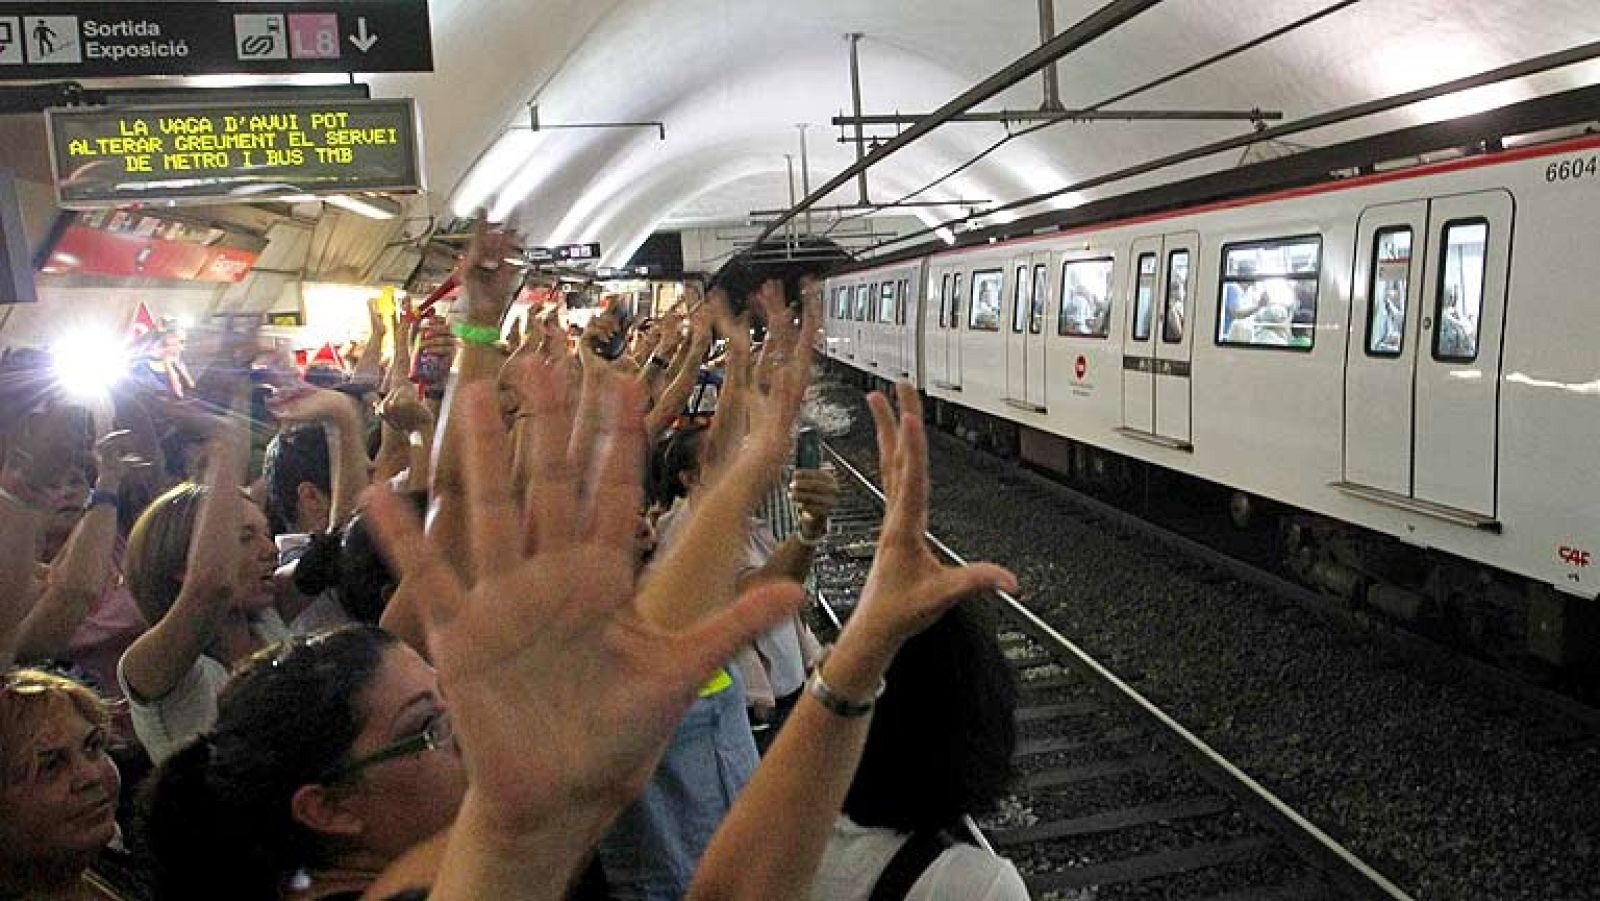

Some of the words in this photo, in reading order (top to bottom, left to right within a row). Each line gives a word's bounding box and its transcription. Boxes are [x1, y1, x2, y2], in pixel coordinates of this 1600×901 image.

[83, 20, 160, 36] Sortida
[86, 40, 189, 60] Exposició
[295, 29, 334, 57] L8
[120, 119, 149, 136] LA
[159, 117, 213, 134] VAGA
[224, 114, 299, 132] D'AVUI
[311, 112, 348, 129] POT
[68, 138, 163, 155] ALTERAR
[175, 133, 276, 151] GREUMENT
[289, 131, 315, 147] EL
[326, 128, 397, 145] SERVEI
[125, 155, 153, 172] DE
[164, 151, 229, 170] METRO
[243, 151, 253, 168] I
[266, 149, 304, 166] BUS
[315, 147, 353, 164] TMB
[1546, 156, 1596, 182] 6604
